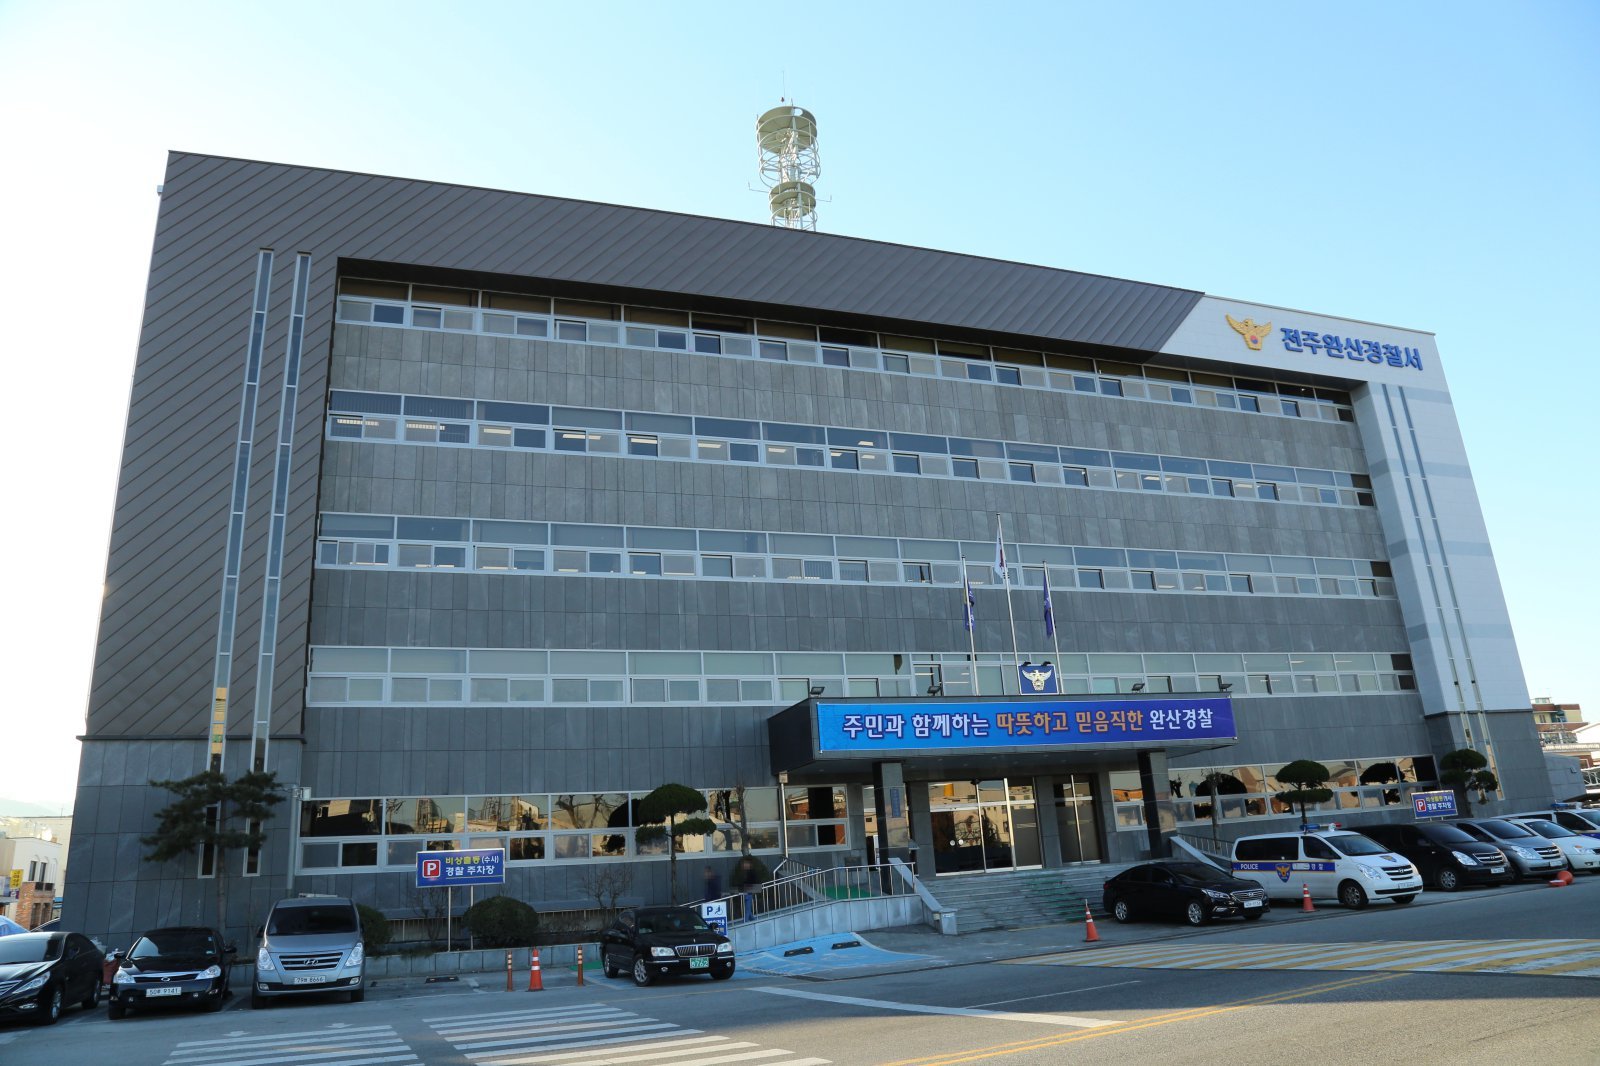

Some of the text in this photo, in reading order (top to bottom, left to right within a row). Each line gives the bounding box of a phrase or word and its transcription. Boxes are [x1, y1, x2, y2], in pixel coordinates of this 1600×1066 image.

[1280, 327, 1423, 371] 전주완산경찰서
[843, 706, 1214, 739] 주민과 함께하는 따뜻하고 믿음직한 완산경찰
[481, 855, 499, 864] (수사)
[427, 862, 437, 876] P
[445, 865, 495, 877] 경찰 주차장
[706, 906, 714, 916] P
